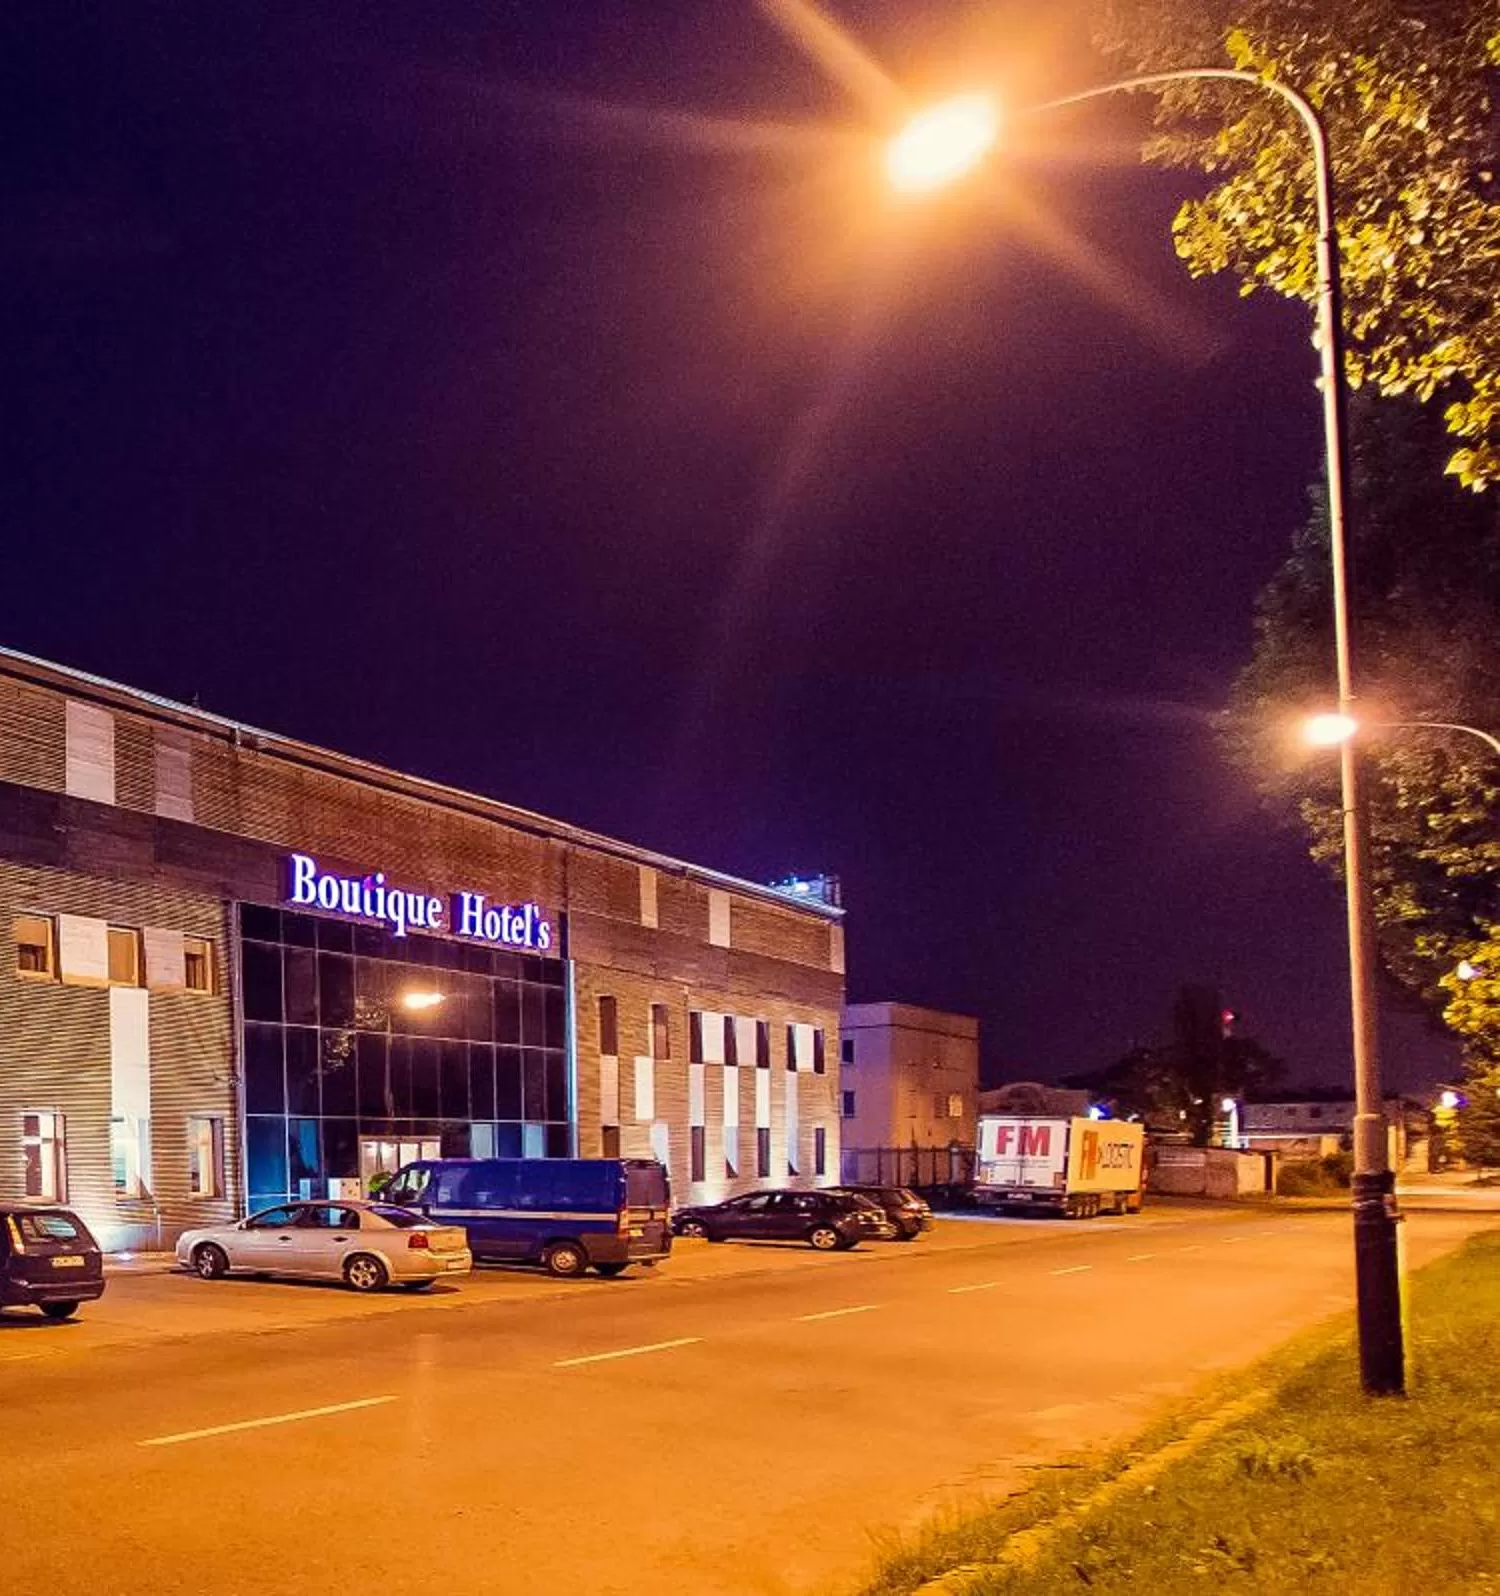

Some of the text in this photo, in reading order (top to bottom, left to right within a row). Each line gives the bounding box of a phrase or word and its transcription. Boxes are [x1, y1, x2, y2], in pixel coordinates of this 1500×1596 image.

[291, 854, 550, 949] Boutique Hotel's
[996, 1125, 1050, 1156] FM
